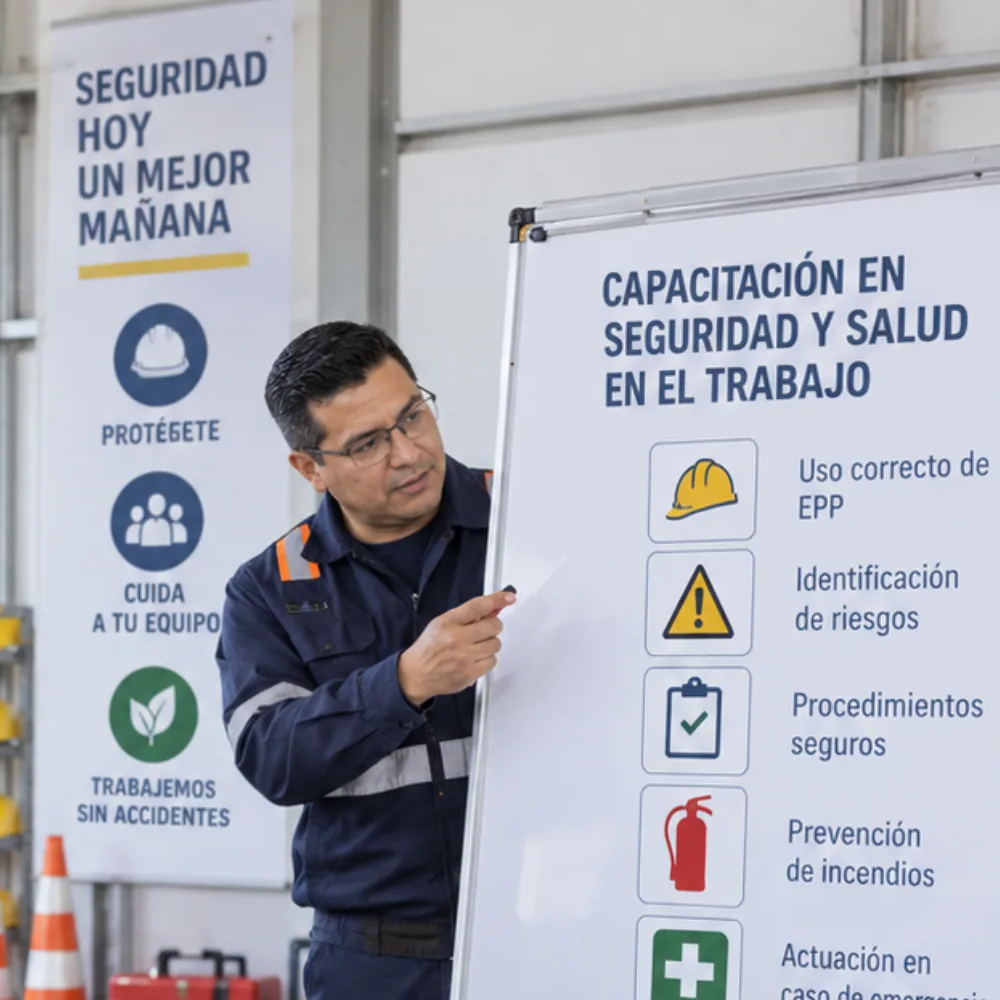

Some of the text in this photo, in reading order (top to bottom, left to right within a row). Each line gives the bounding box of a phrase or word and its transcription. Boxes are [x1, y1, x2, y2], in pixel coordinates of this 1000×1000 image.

[76, 50, 267, 106] SEGURIDAD
[78, 111, 152, 153] HOY
[78, 149, 251, 200] UN MEJOR
[79, 197, 231, 246] MAÑANA
[602, 250, 905, 308] CAPACITACIÓN EN
[604, 303, 968, 358] SEGURIDAD Y SALUD
[605, 360, 871, 407] EN EL TRABAJO
[799, 450, 990, 484] Uso correcto de
[799, 494, 844, 520] EPP
[124, 582, 186, 604] CUIDA
[796, 562, 959, 592] Identificación
[92, 611, 221, 635] A TU EQUIPO
[795, 604, 919, 637] de riesgos
[793, 691, 984, 718] Procedimientos
[791, 736, 886, 762] seguros
[91, 776, 217, 799] TRABAJEMOS
[77, 803, 231, 828] SIN ACCIDENTES
[788, 818, 921, 848] Prevención
[786, 857, 935, 888] de incendios
[781, 942, 931, 975] Actuación en
